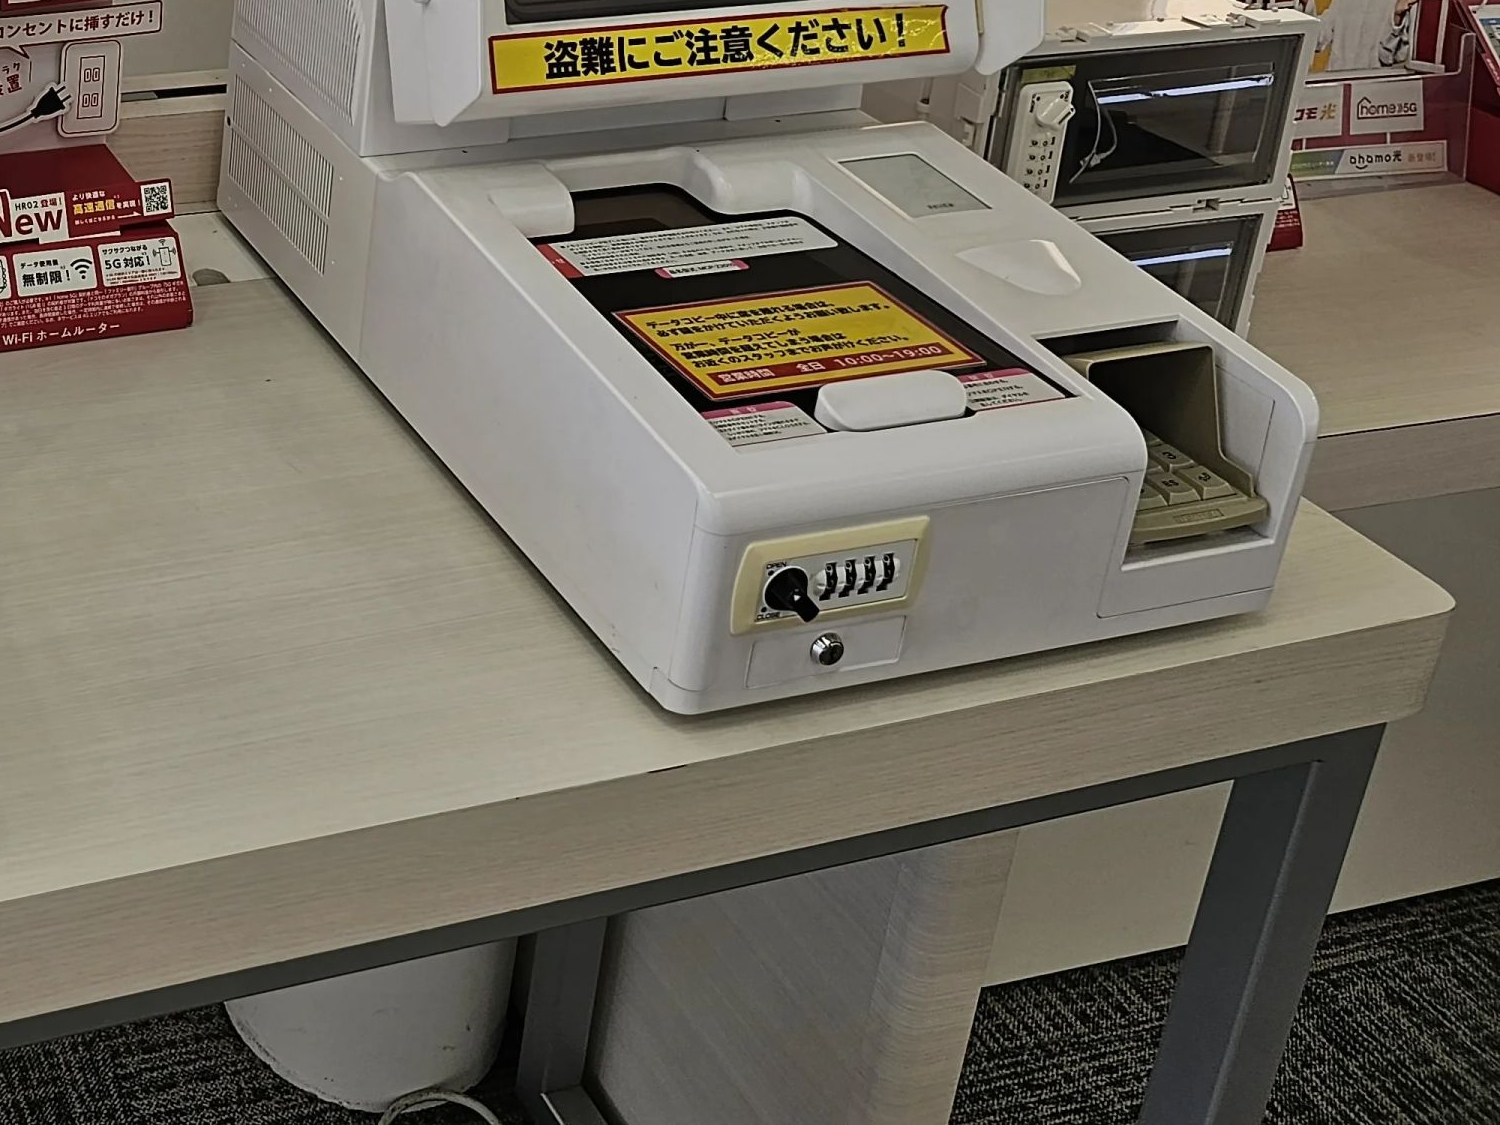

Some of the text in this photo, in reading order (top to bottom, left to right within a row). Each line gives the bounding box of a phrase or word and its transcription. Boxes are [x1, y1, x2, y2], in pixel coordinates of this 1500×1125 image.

[543, 12, 908, 80] 盗難にご注意ください！
[2, 331, 34, 346] Wi-Fi
[36, 323, 121, 341] ホームルーター
[795, 360, 827, 373] 全日
